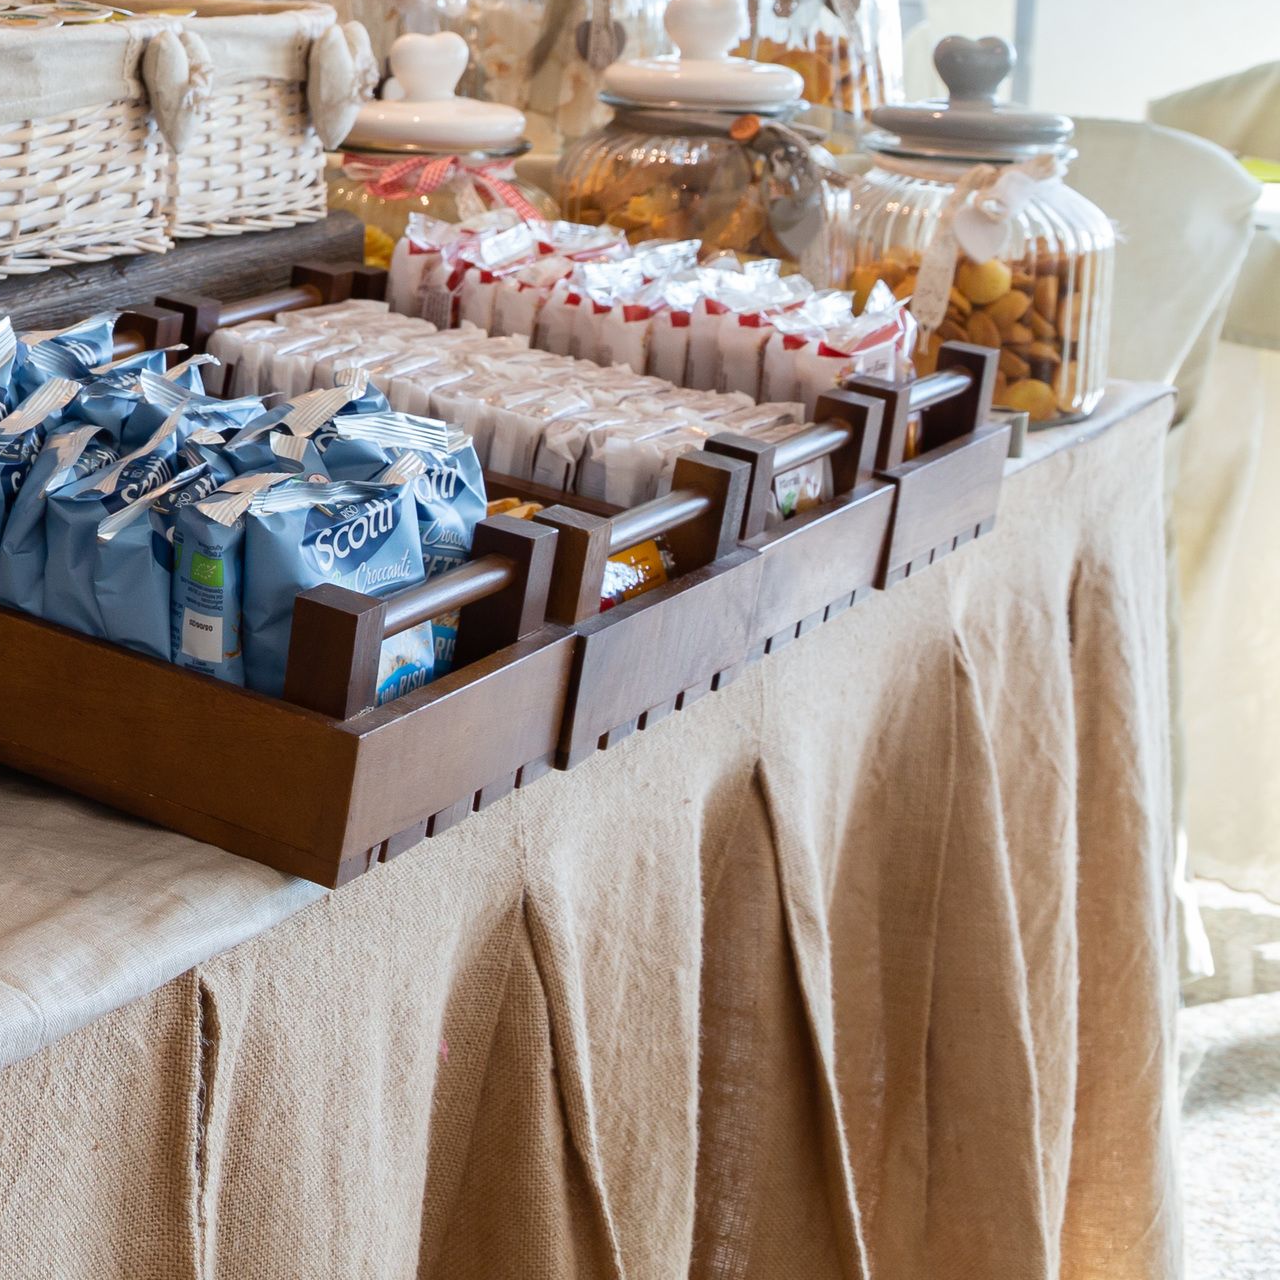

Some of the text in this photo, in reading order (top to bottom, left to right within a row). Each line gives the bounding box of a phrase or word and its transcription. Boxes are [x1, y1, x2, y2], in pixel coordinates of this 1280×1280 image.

[413, 463, 458, 504] otti
[340, 504, 359, 521] RISO
[315, 497, 394, 572] Scotti
[354, 548, 412, 593] Croccanti
[399, 666, 427, 698] RISO
